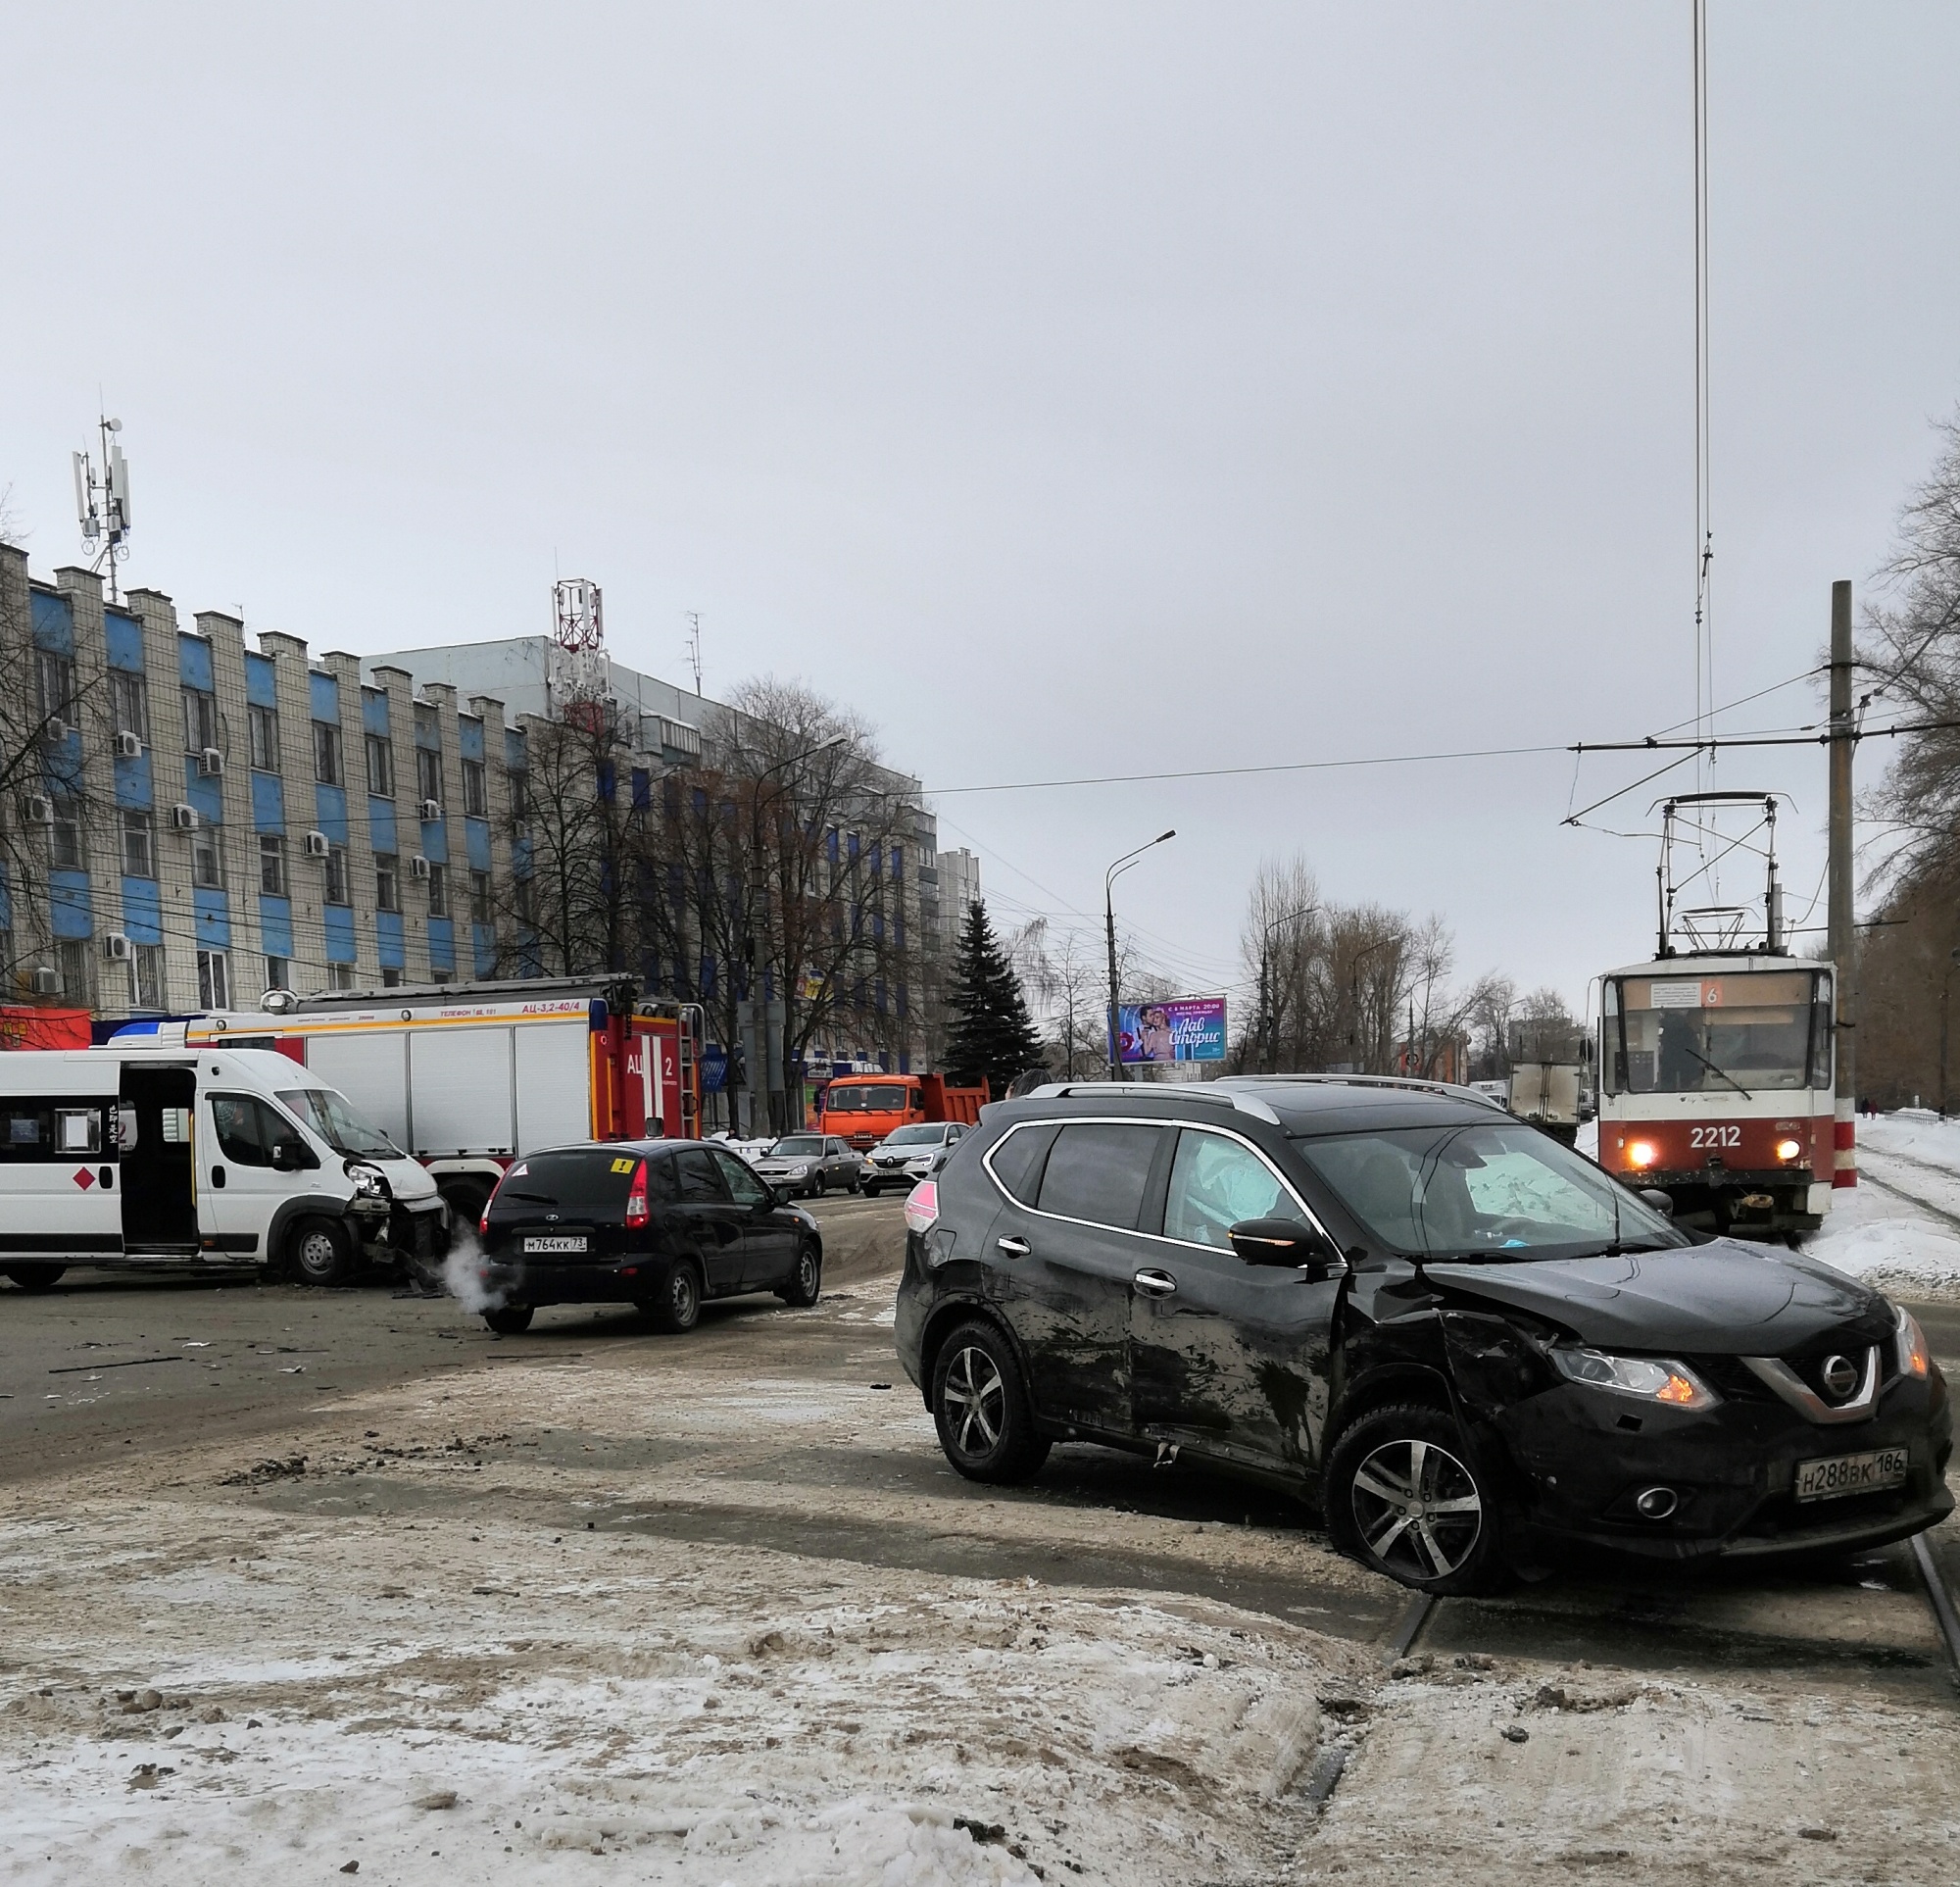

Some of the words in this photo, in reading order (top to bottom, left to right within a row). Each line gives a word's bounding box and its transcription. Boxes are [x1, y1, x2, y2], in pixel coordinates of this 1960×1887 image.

[1707, 986, 1717, 1003] 6
[440, 1009, 471, 1018] ТЕЛЕФОН
[521, 1001, 580, 1014] АЦ-3,2-40/4
[627, 1054, 644, 1078] АЦ
[665, 1057, 673, 1076] 2
[1690, 1125, 1741, 1148] 2212
[1803, 1462, 1873, 1493] Н288ВК
[1876, 1452, 1903, 1473] 186
